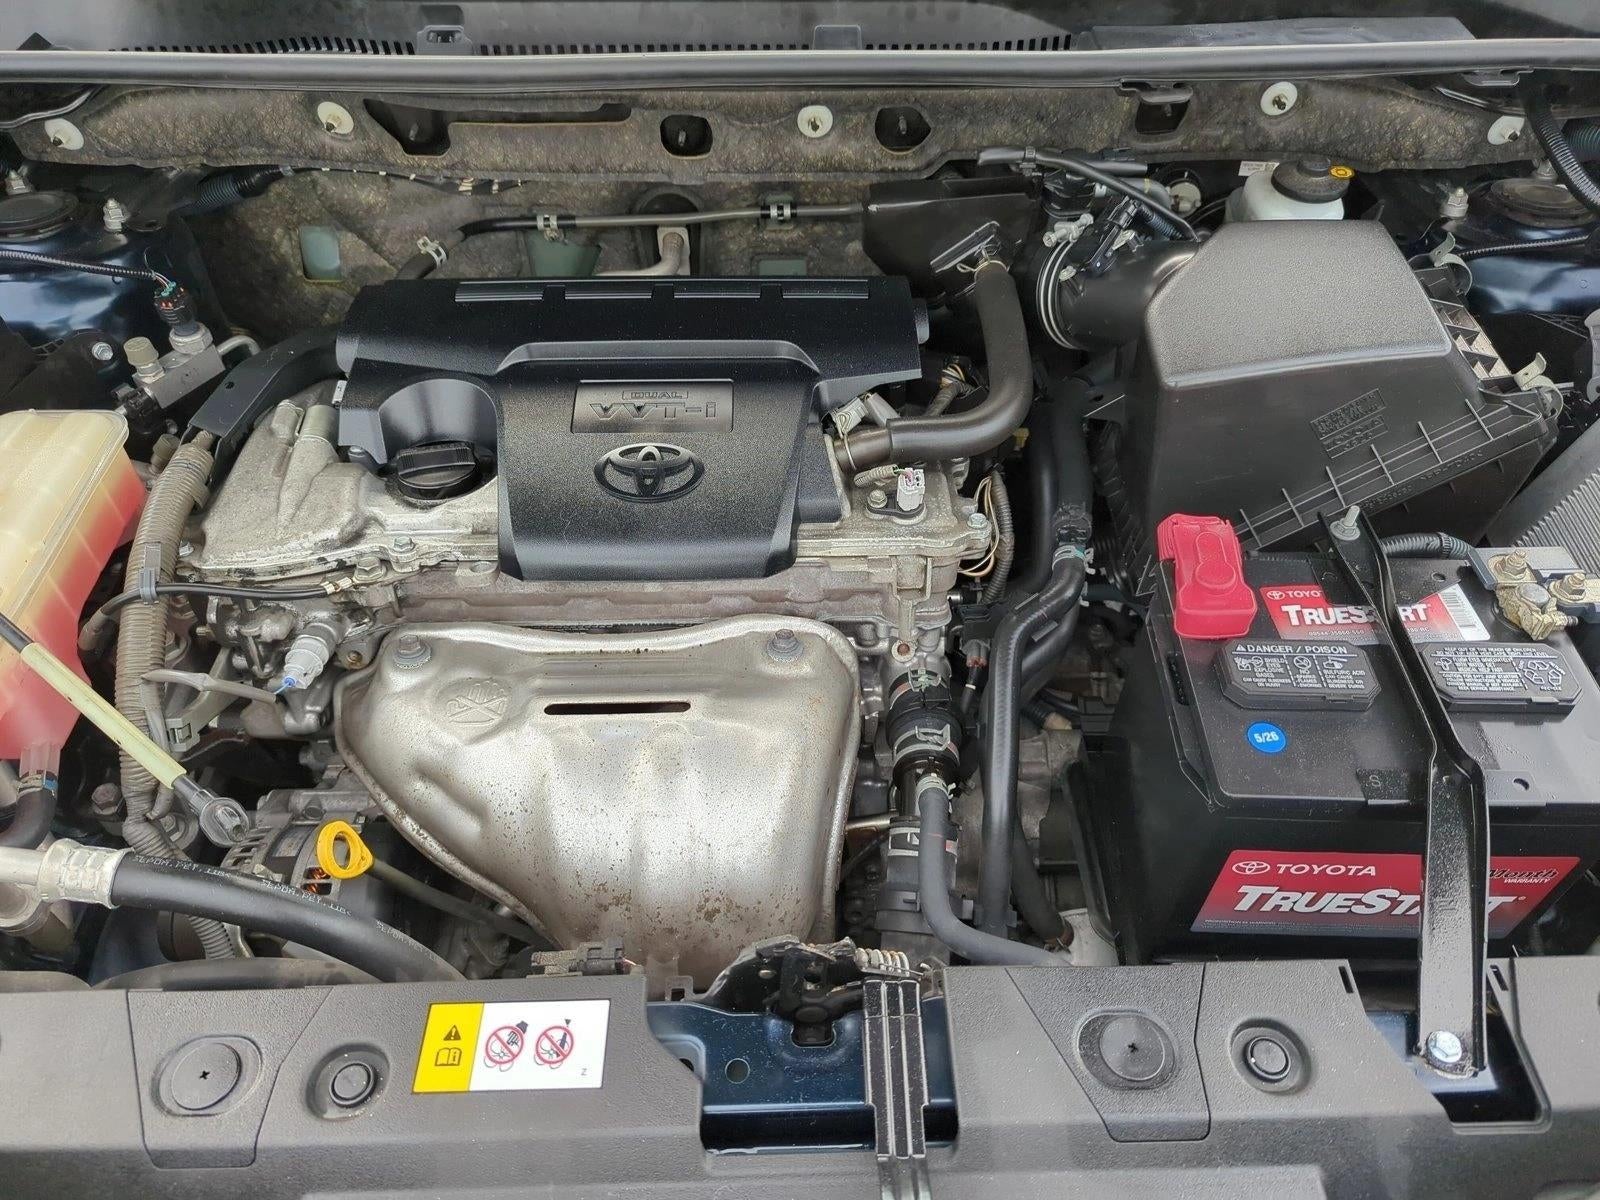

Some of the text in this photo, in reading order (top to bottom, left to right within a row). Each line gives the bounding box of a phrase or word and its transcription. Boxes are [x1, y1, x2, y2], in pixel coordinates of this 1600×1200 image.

[629, 390, 684, 399] DUAL
[589, 402, 717, 420] VVT-i
[1287, 590, 1322, 599] TOYO
[1246, 644, 1293, 653] DANGER
[1304, 646, 1348, 654] POISON
[1253, 730, 1280, 744] 5/26
[1276, 863, 1376, 876] TOYOTA
